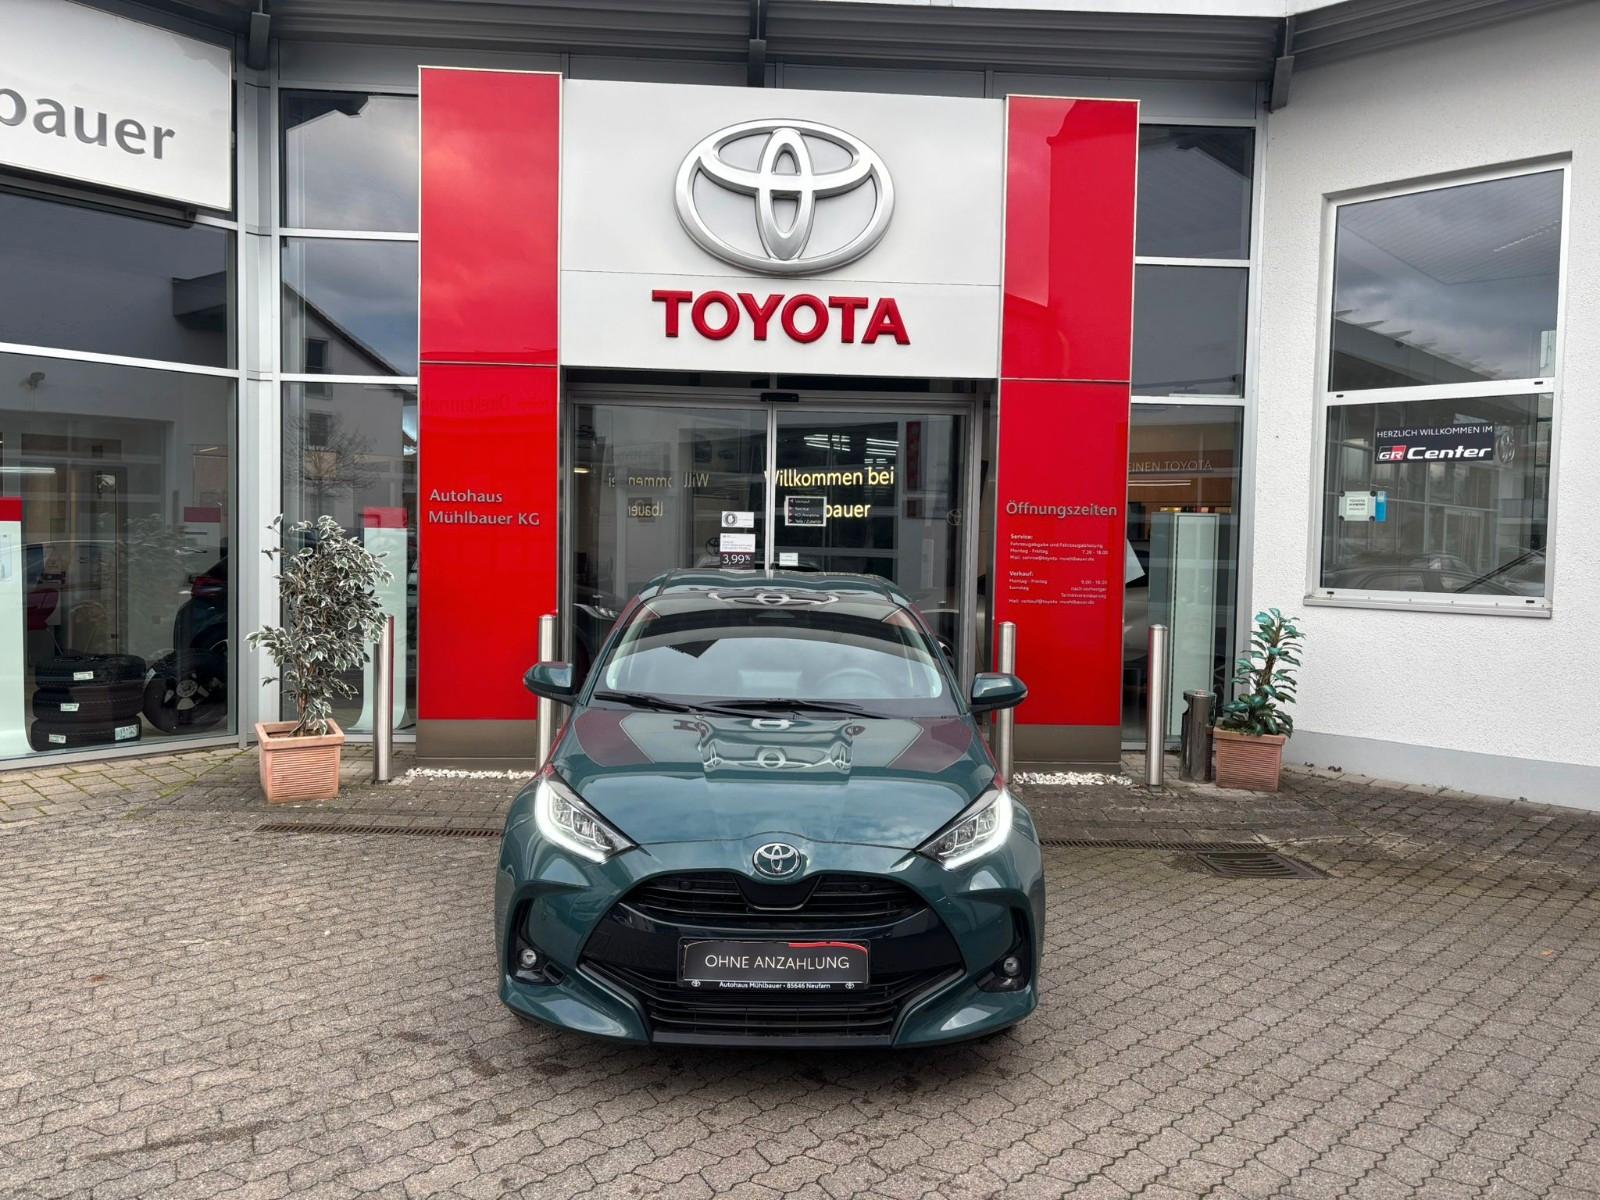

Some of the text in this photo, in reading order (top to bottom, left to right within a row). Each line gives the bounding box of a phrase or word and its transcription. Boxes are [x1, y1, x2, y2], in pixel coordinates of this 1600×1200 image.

[651, 289, 911, 346] TOYOTA
[1376, 425, 1493, 438] HERZLICH WILLKOMMEN IM
[1379, 445, 1492, 460] GR Center
[1164, 459, 1213, 472] TOYOTA
[867, 465, 895, 486] bei
[428, 488, 504, 504] Autohaus
[1006, 499, 1118, 519] Öffnungszeiten
[428, 510, 541, 527] Mühlbauer KG
[704, 954, 850, 971] OHNE ANZAHLUNG
[719, 981, 749, 989] Autohaus
